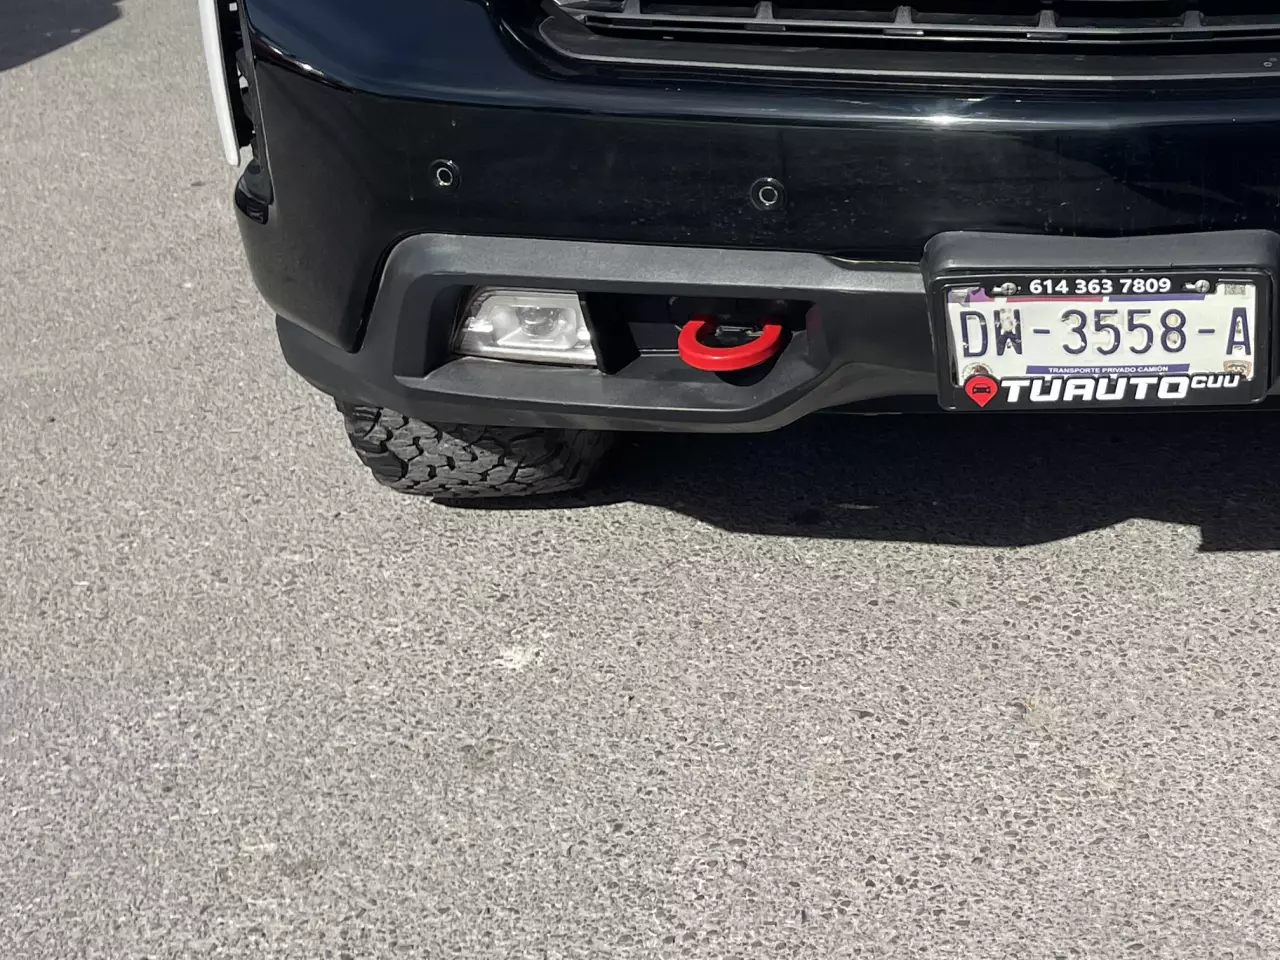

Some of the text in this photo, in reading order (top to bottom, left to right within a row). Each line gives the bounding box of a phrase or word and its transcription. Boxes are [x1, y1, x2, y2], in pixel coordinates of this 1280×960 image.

[1029, 277, 1171, 294] 614 363 7809
[1048, 366, 1100, 374] TRANSPORTE
[1101, 366, 1136, 374] PRIVADO
